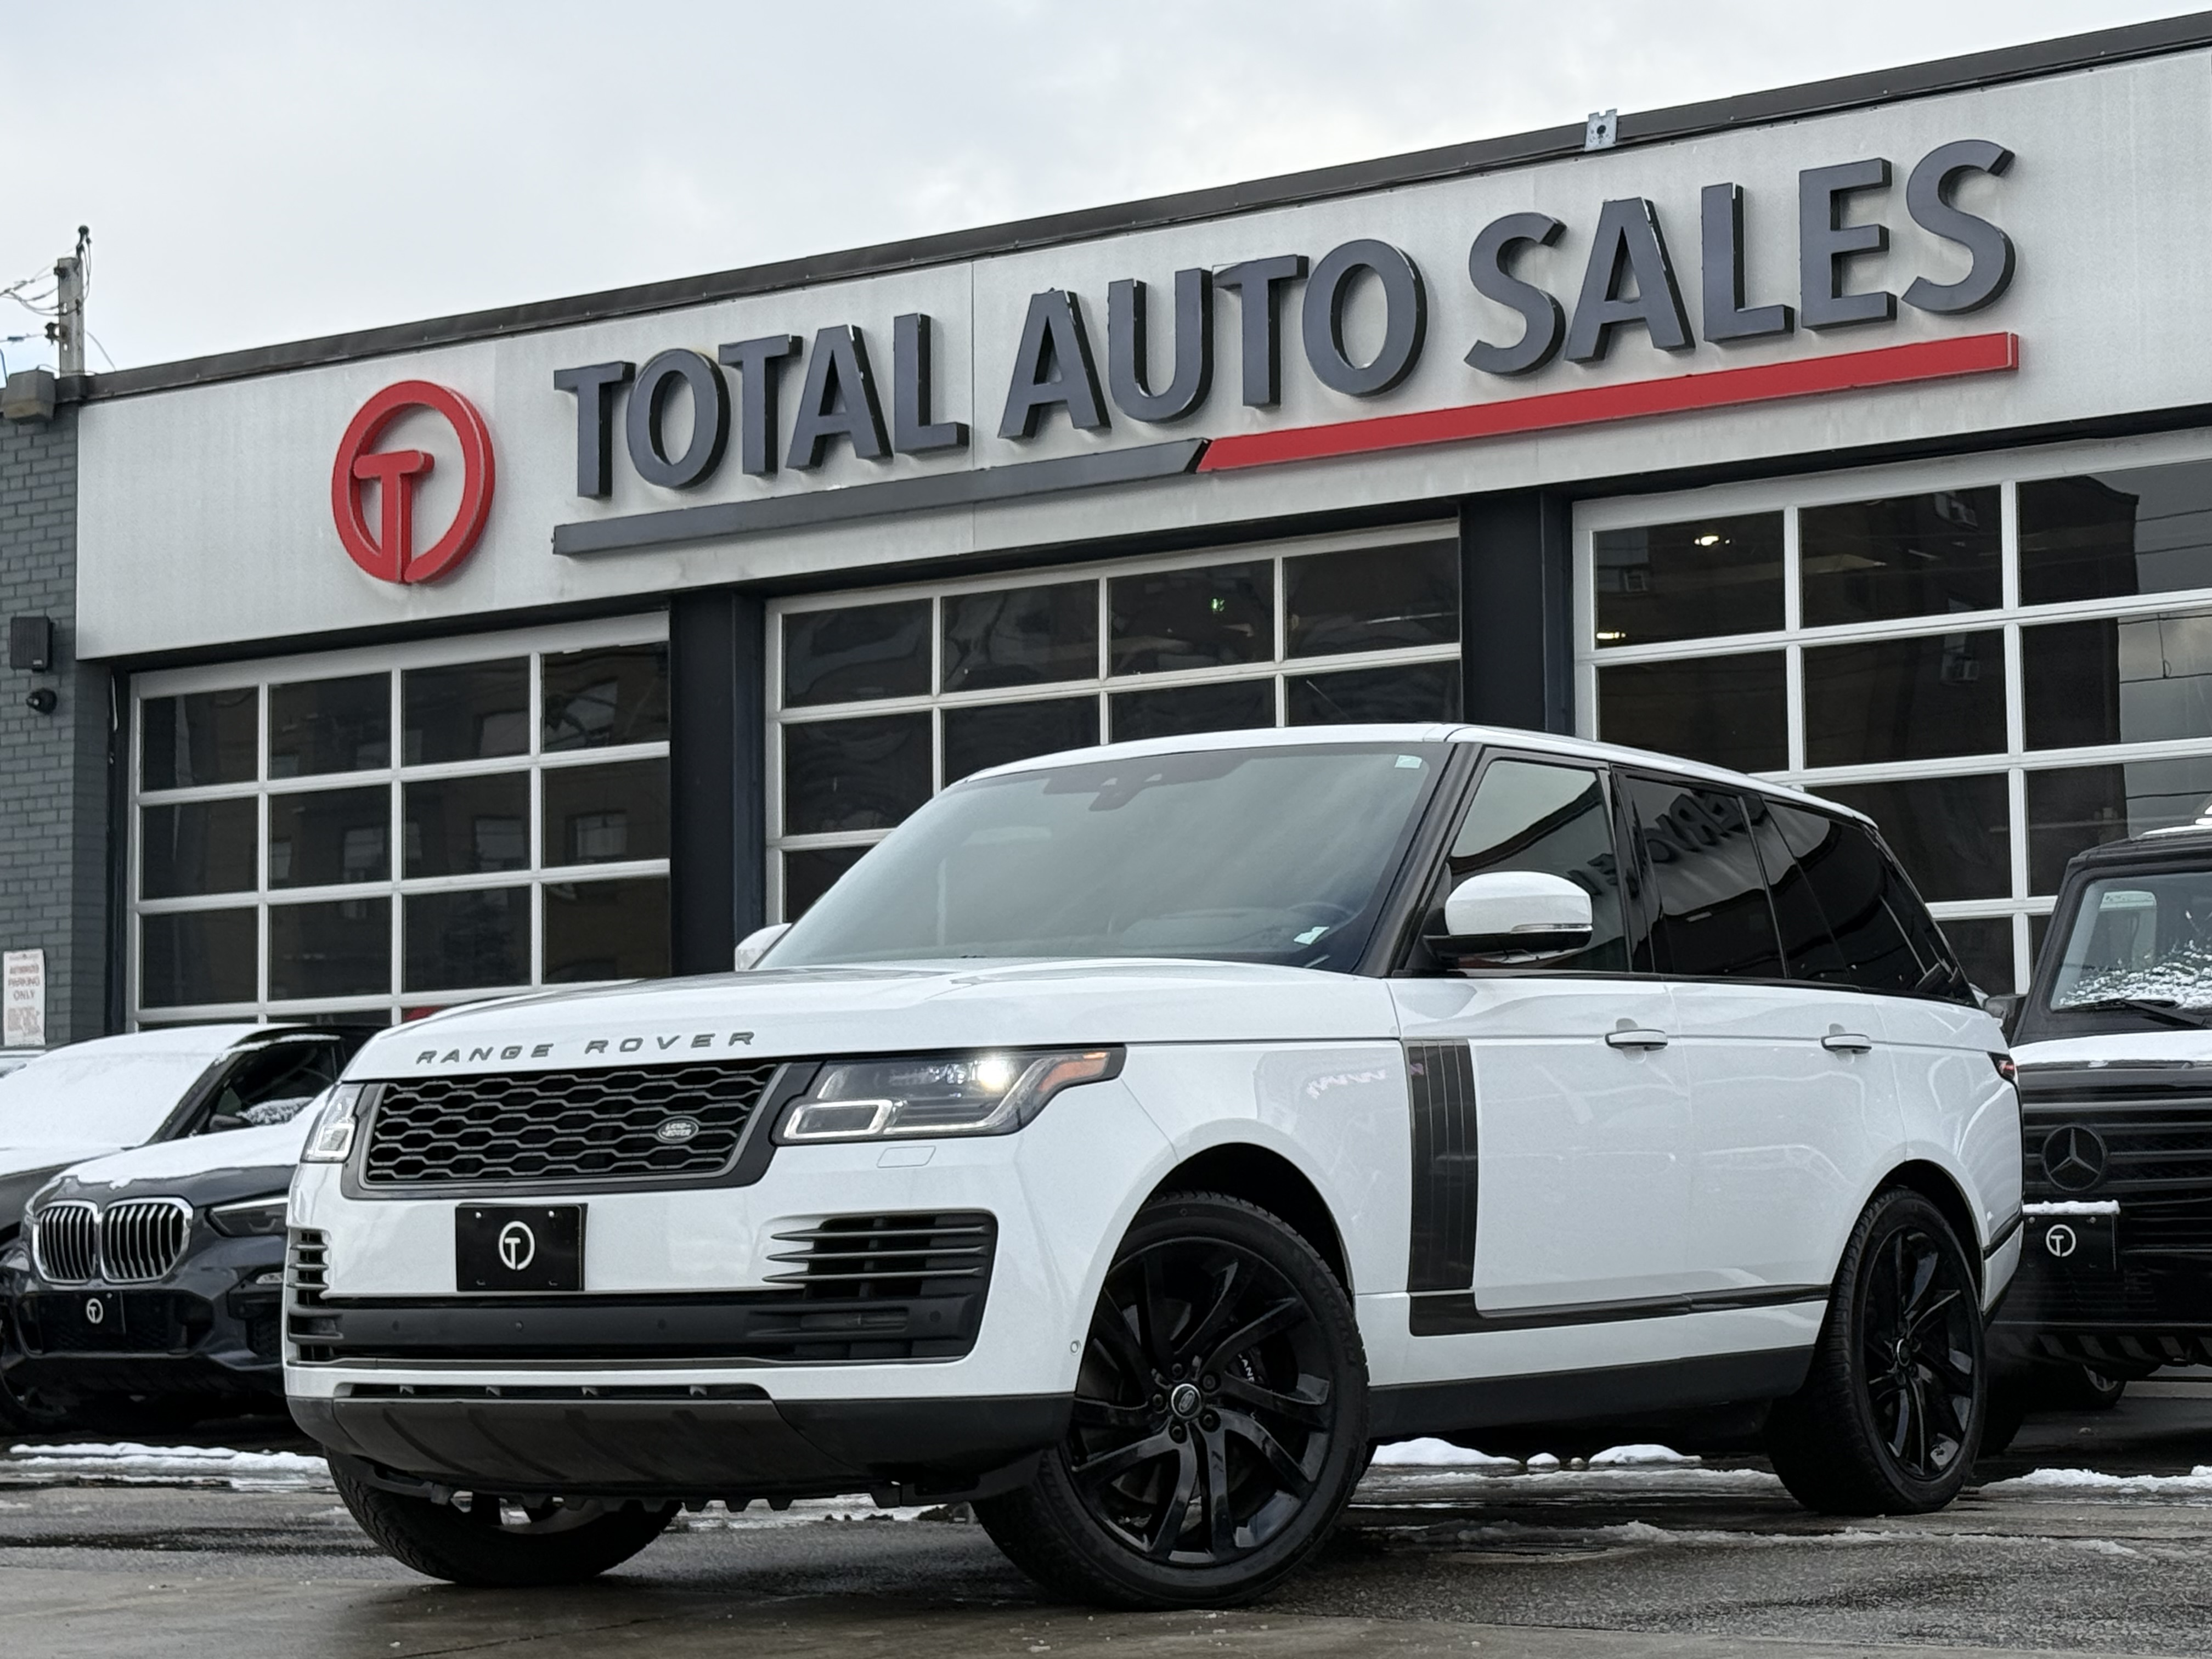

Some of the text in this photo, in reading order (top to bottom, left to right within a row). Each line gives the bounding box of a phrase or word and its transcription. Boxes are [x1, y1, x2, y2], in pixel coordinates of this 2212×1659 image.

[554, 138, 2016, 499] TOTAL AUTO SALES
[13, 989, 35, 1001] ONLY
[416, 1031, 755, 1065] RANGE ROVER
